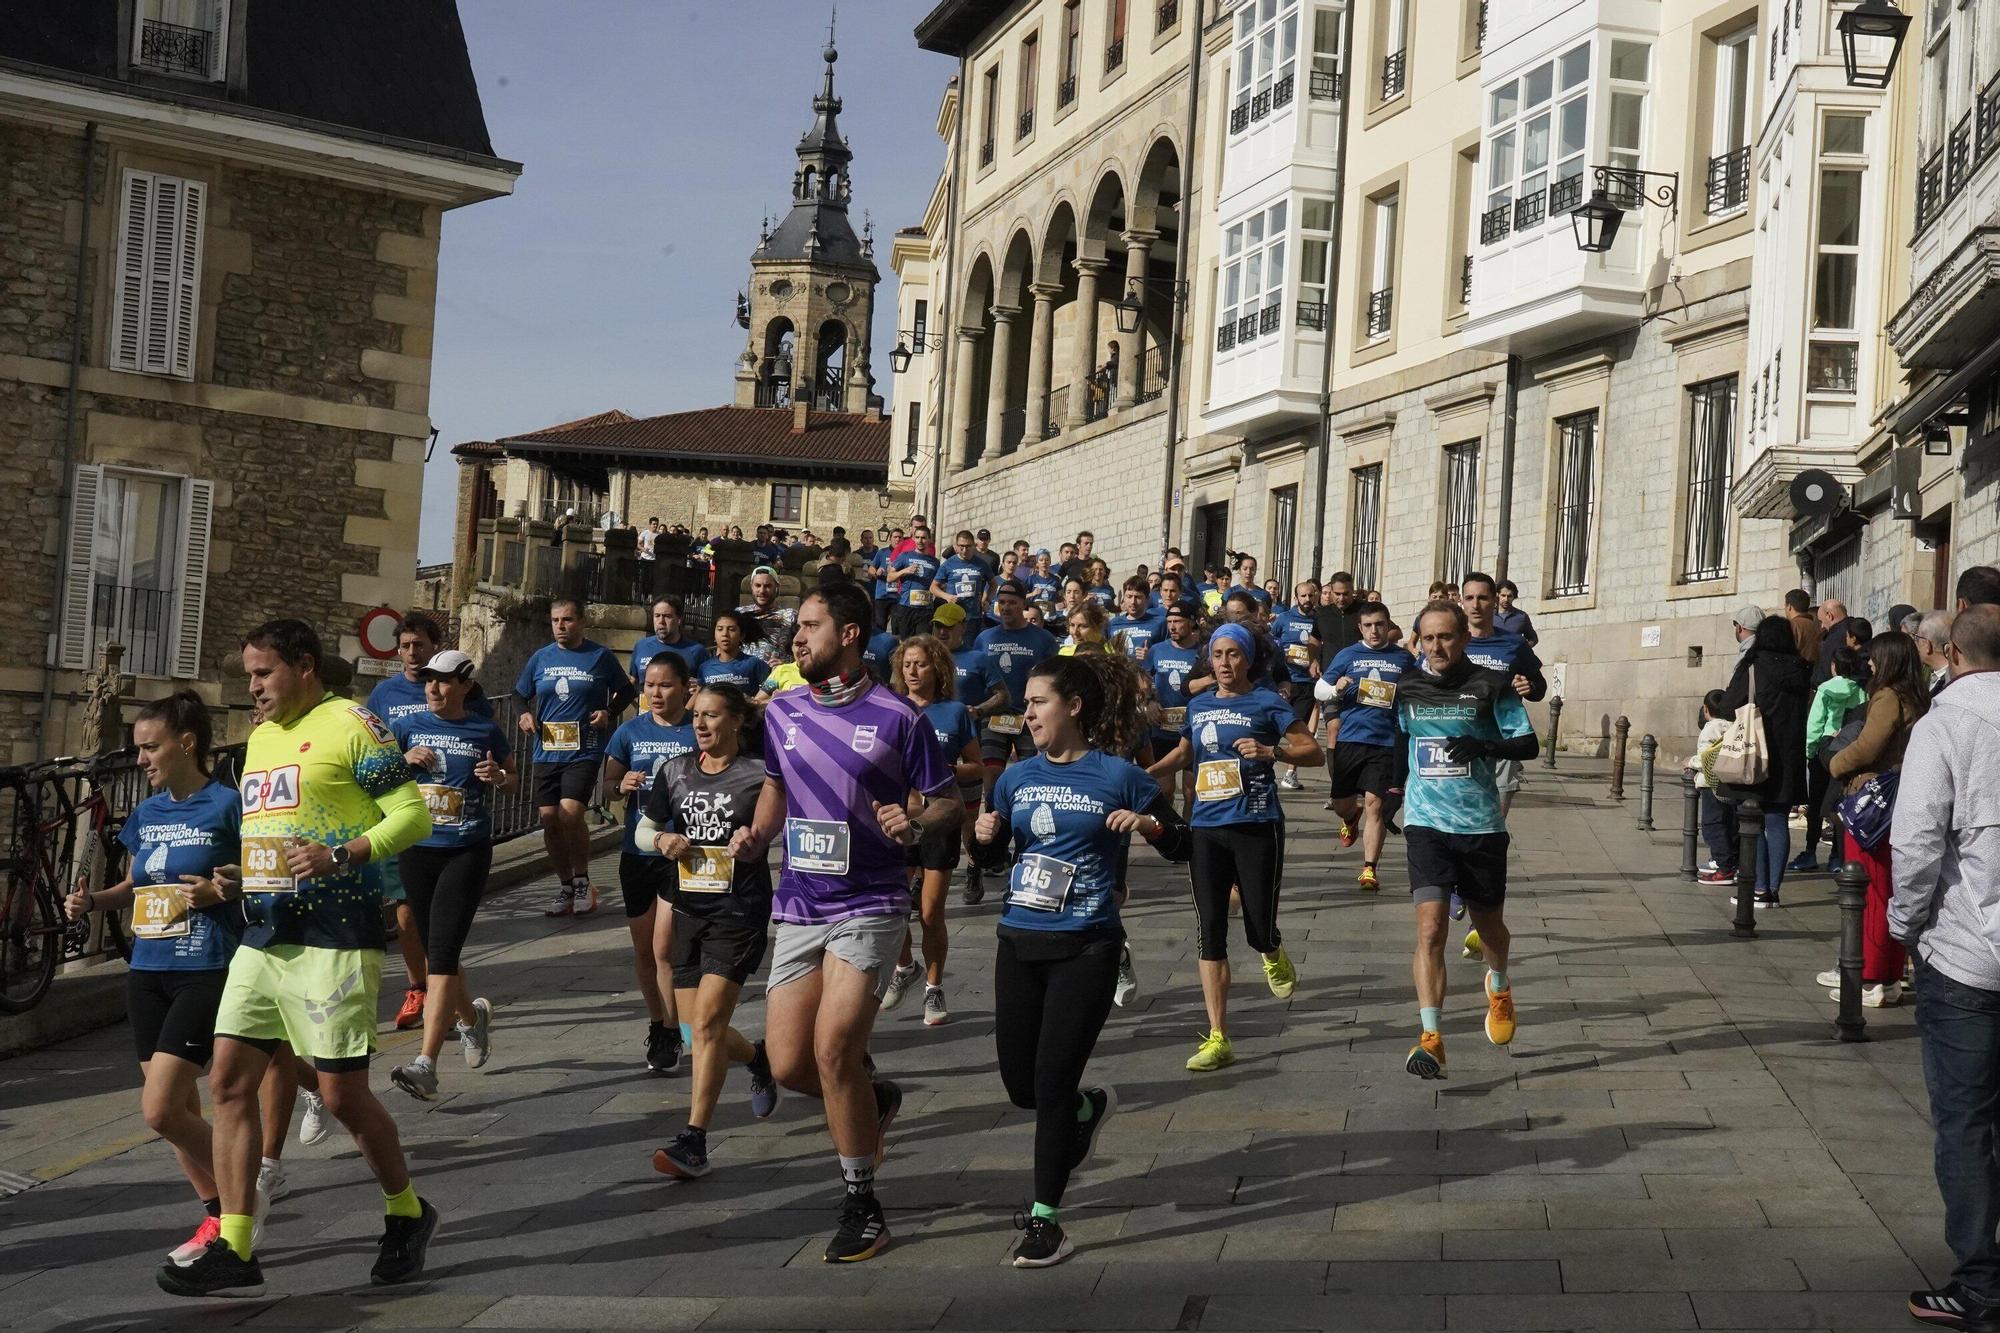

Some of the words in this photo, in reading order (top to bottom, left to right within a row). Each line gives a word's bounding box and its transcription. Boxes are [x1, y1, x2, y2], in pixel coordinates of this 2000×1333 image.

[1924, 540, 1930, 550] 2
[397, 704, 429, 712] CONQUIST
[1416, 704, 1476, 716] bertako
[420, 740, 474, 750] ALMENDRA
[641, 746, 694, 754] ALMENDRA
[1206, 770, 1227, 786] 156
[1023, 786, 1072, 794] CONQUISTA
[680, 791, 710, 814] 45
[1021, 793, 1090, 804] ALMENDRA
[1054, 802, 1104, 814] KONKISTA
[682, 812, 721, 828] VILLA
[146, 824, 187, 832] CONQUISTA
[145, 828, 200, 842] ALMENDRA
[170, 838, 213, 848] KONKISTA
[798, 832, 836, 854] 1057
[248, 849, 277, 870] 433
[1020, 866, 1052, 890] 845
[146, 898, 170, 918] 321
